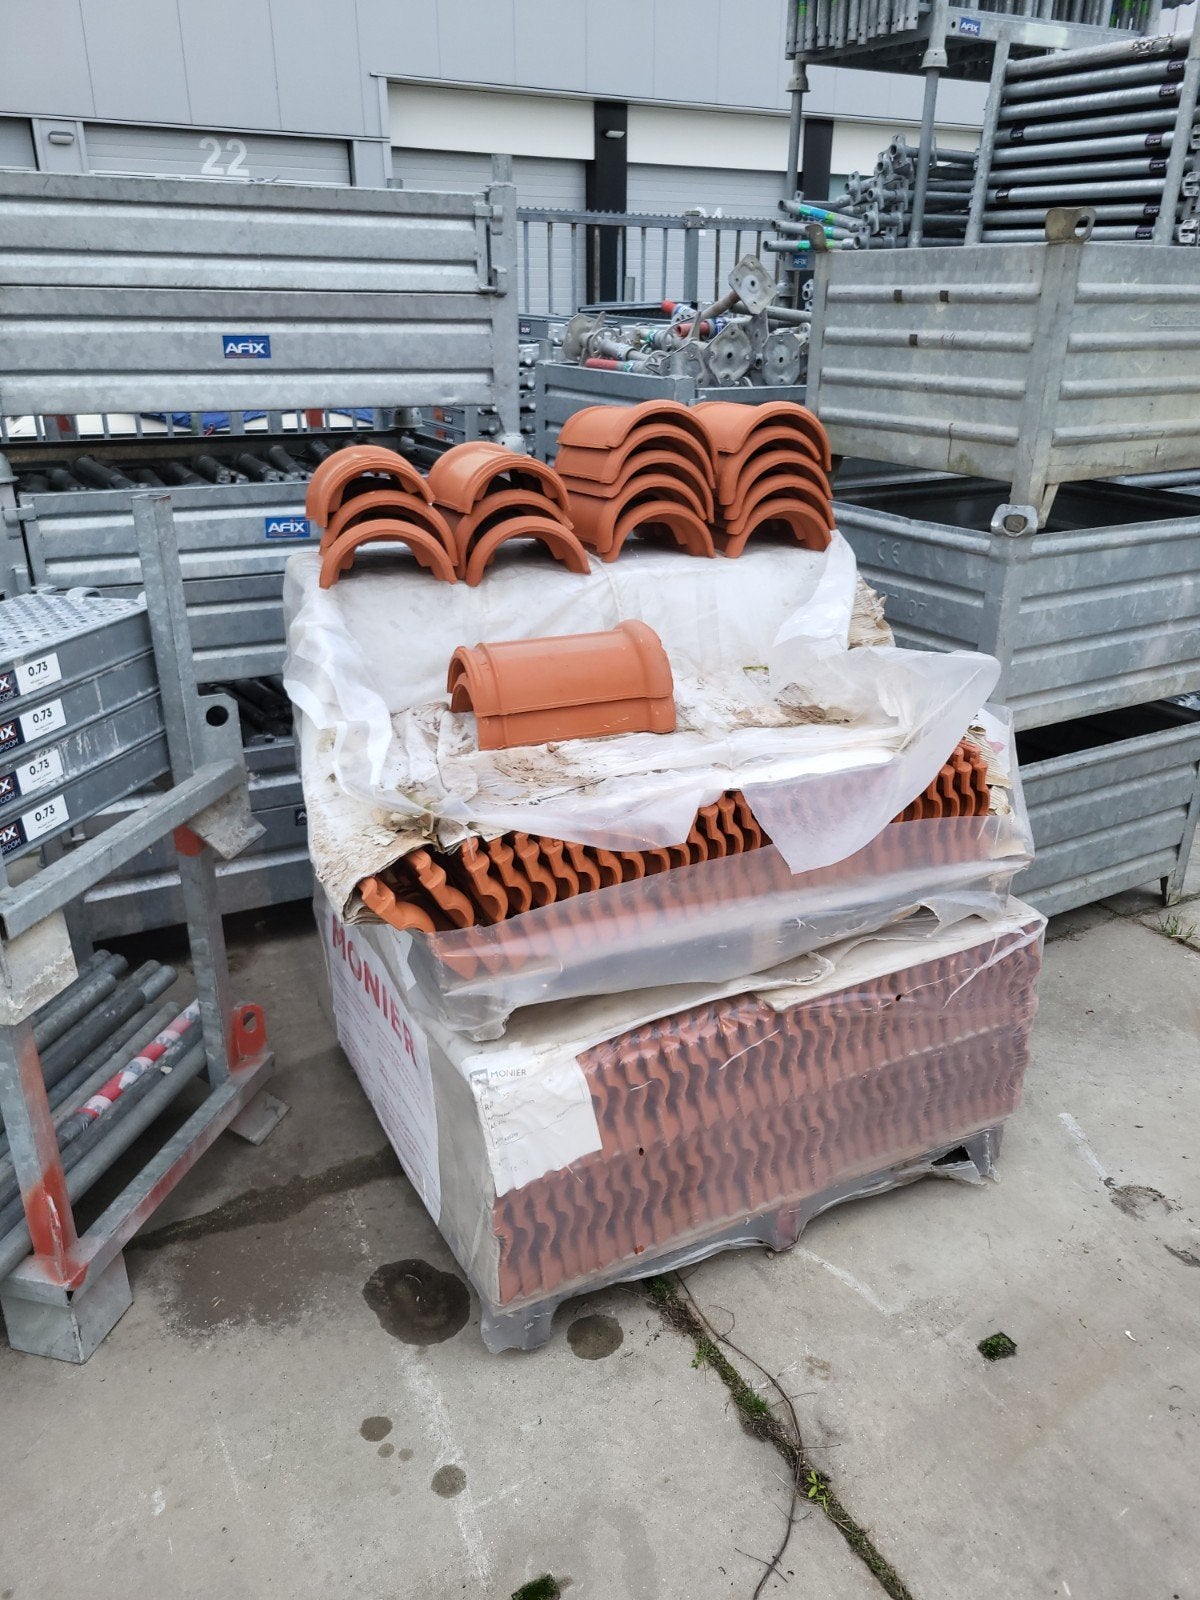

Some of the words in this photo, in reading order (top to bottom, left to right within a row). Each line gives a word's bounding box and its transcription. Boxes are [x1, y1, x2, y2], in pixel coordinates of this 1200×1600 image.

[199, 136, 250, 177] 22
[225, 341, 266, 354] AFIX
[268, 521, 305, 533] AFIX
[28, 661, 48, 677] 0.73
[33, 707, 53, 723] 0.73
[29, 758, 50, 775] 0.73
[34, 805, 55, 822] 0.73
[331, 915, 419, 1070] MONIER
[490, 1069, 527, 1078] MONIER
